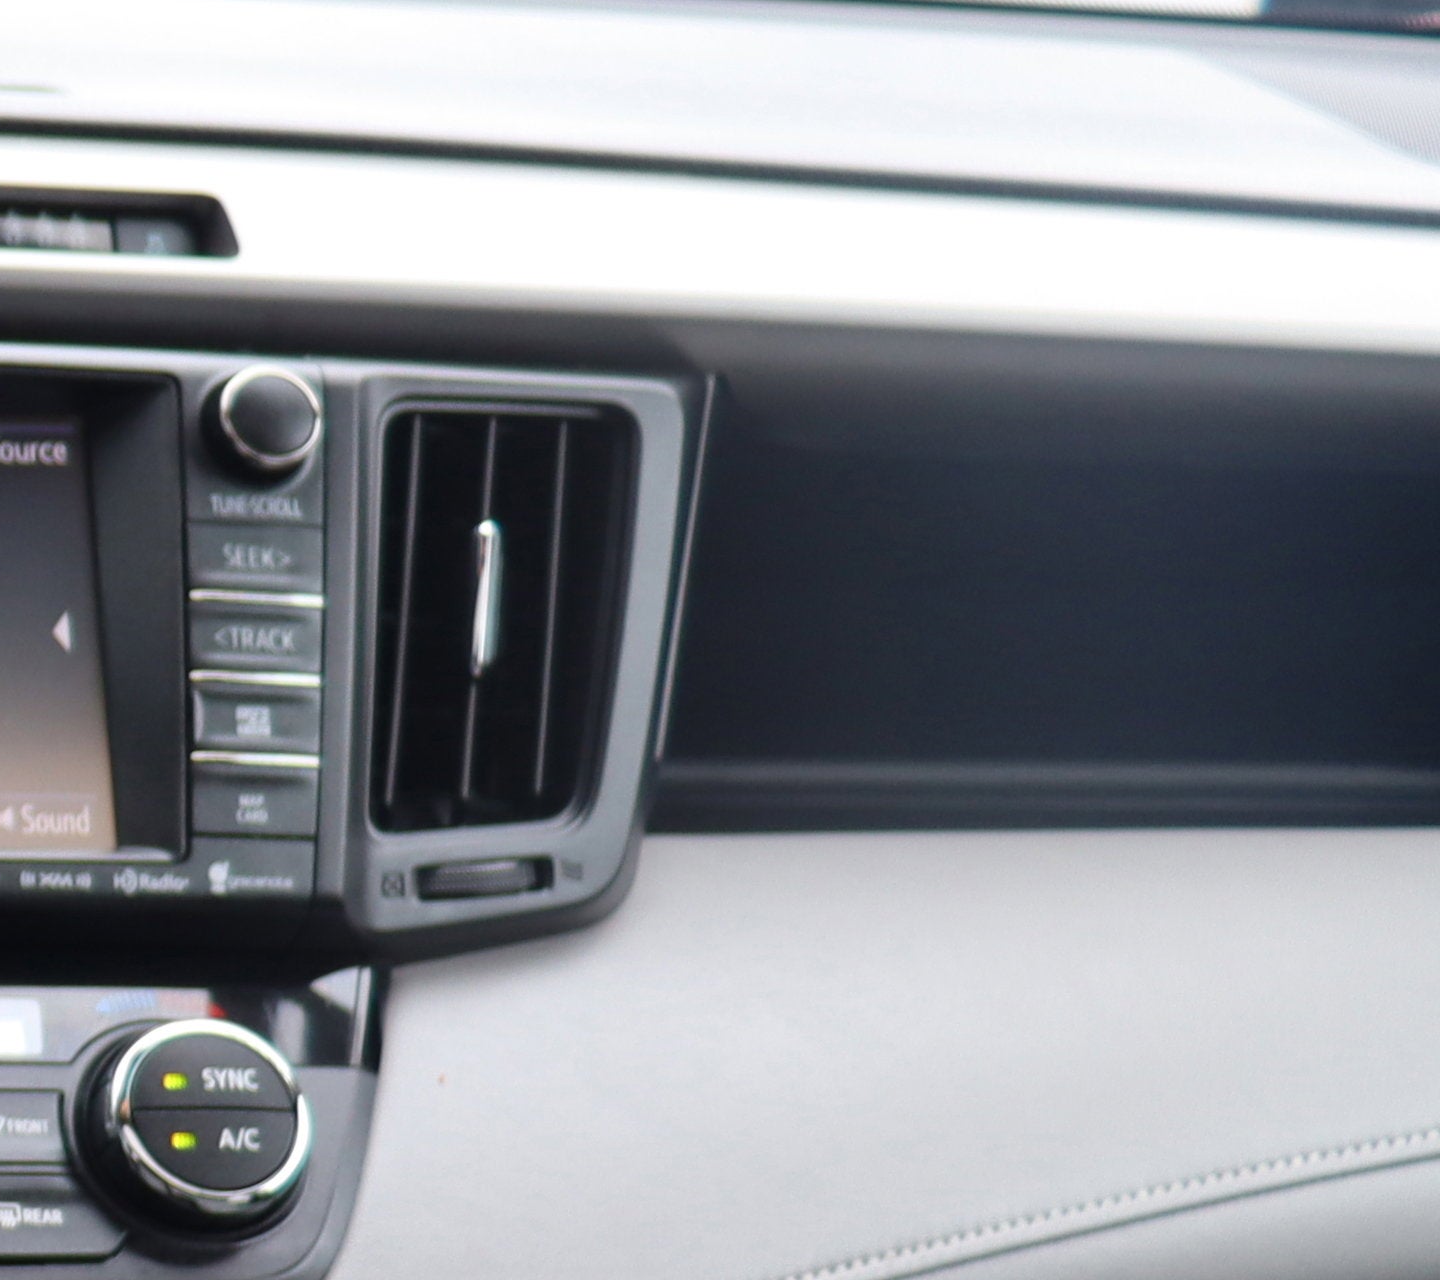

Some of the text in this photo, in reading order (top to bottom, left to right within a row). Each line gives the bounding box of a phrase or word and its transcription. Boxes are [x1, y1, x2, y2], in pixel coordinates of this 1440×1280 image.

[20, 805, 92, 835] Sound
[200, 1065, 260, 1093] SYNC
[218, 1126, 261, 1152] A/C
[22, 1207, 64, 1225] REAR
